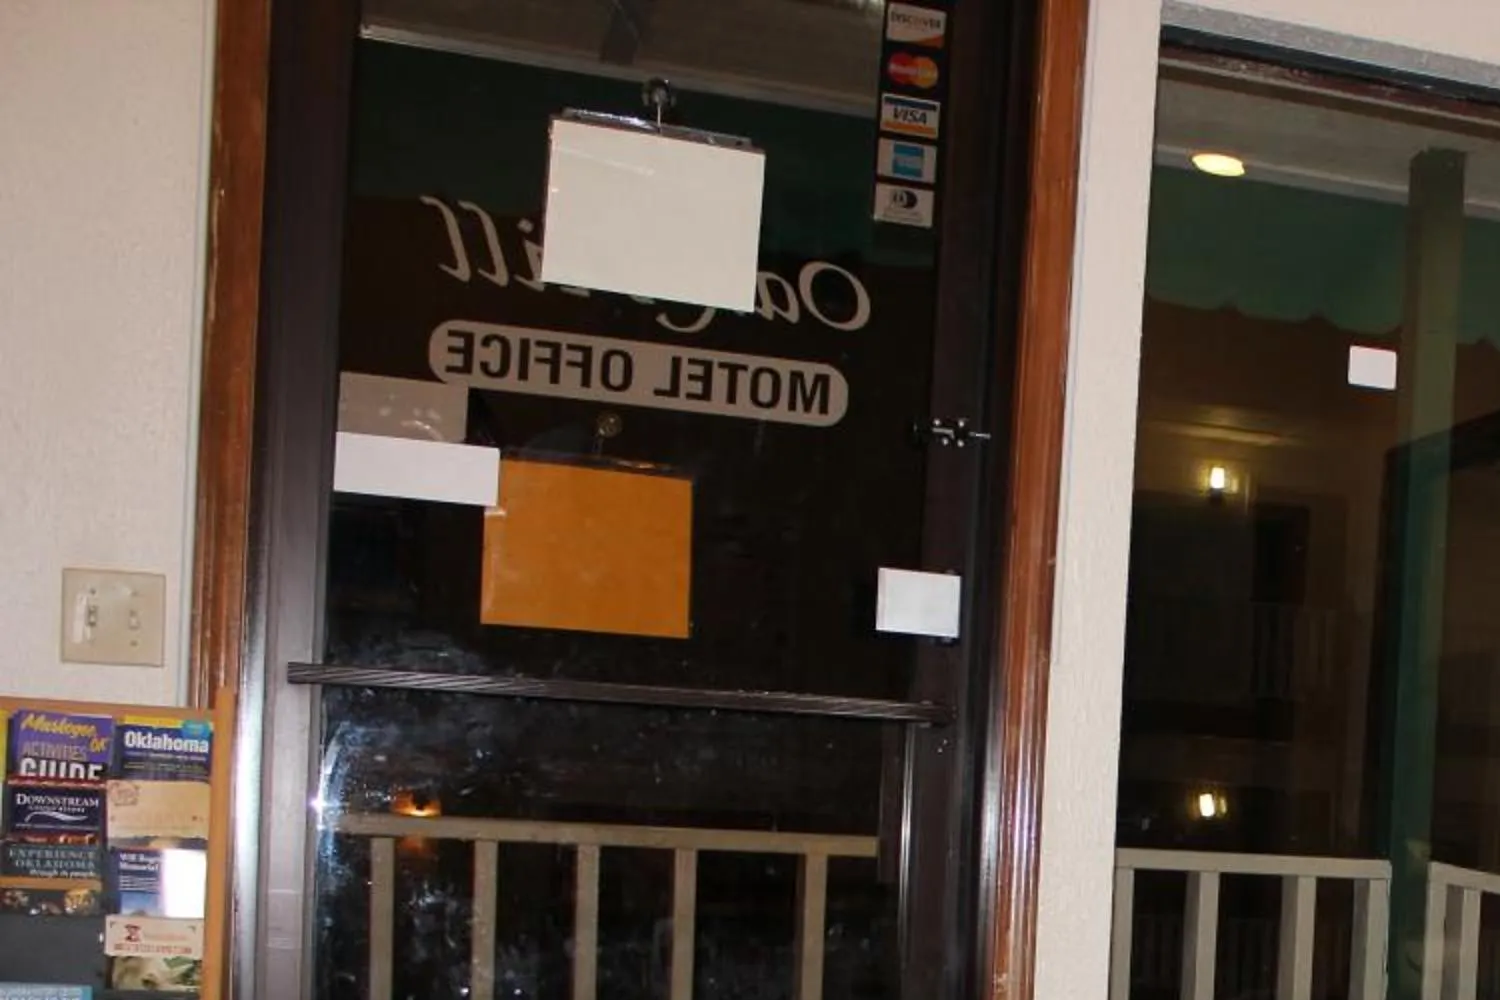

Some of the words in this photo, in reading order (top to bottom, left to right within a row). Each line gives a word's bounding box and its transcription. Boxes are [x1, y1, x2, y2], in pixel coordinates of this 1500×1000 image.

[893, 106, 928, 125] VISA
[124, 730, 209, 753] Oklahoma
[20, 757, 103, 780] GUIDE
